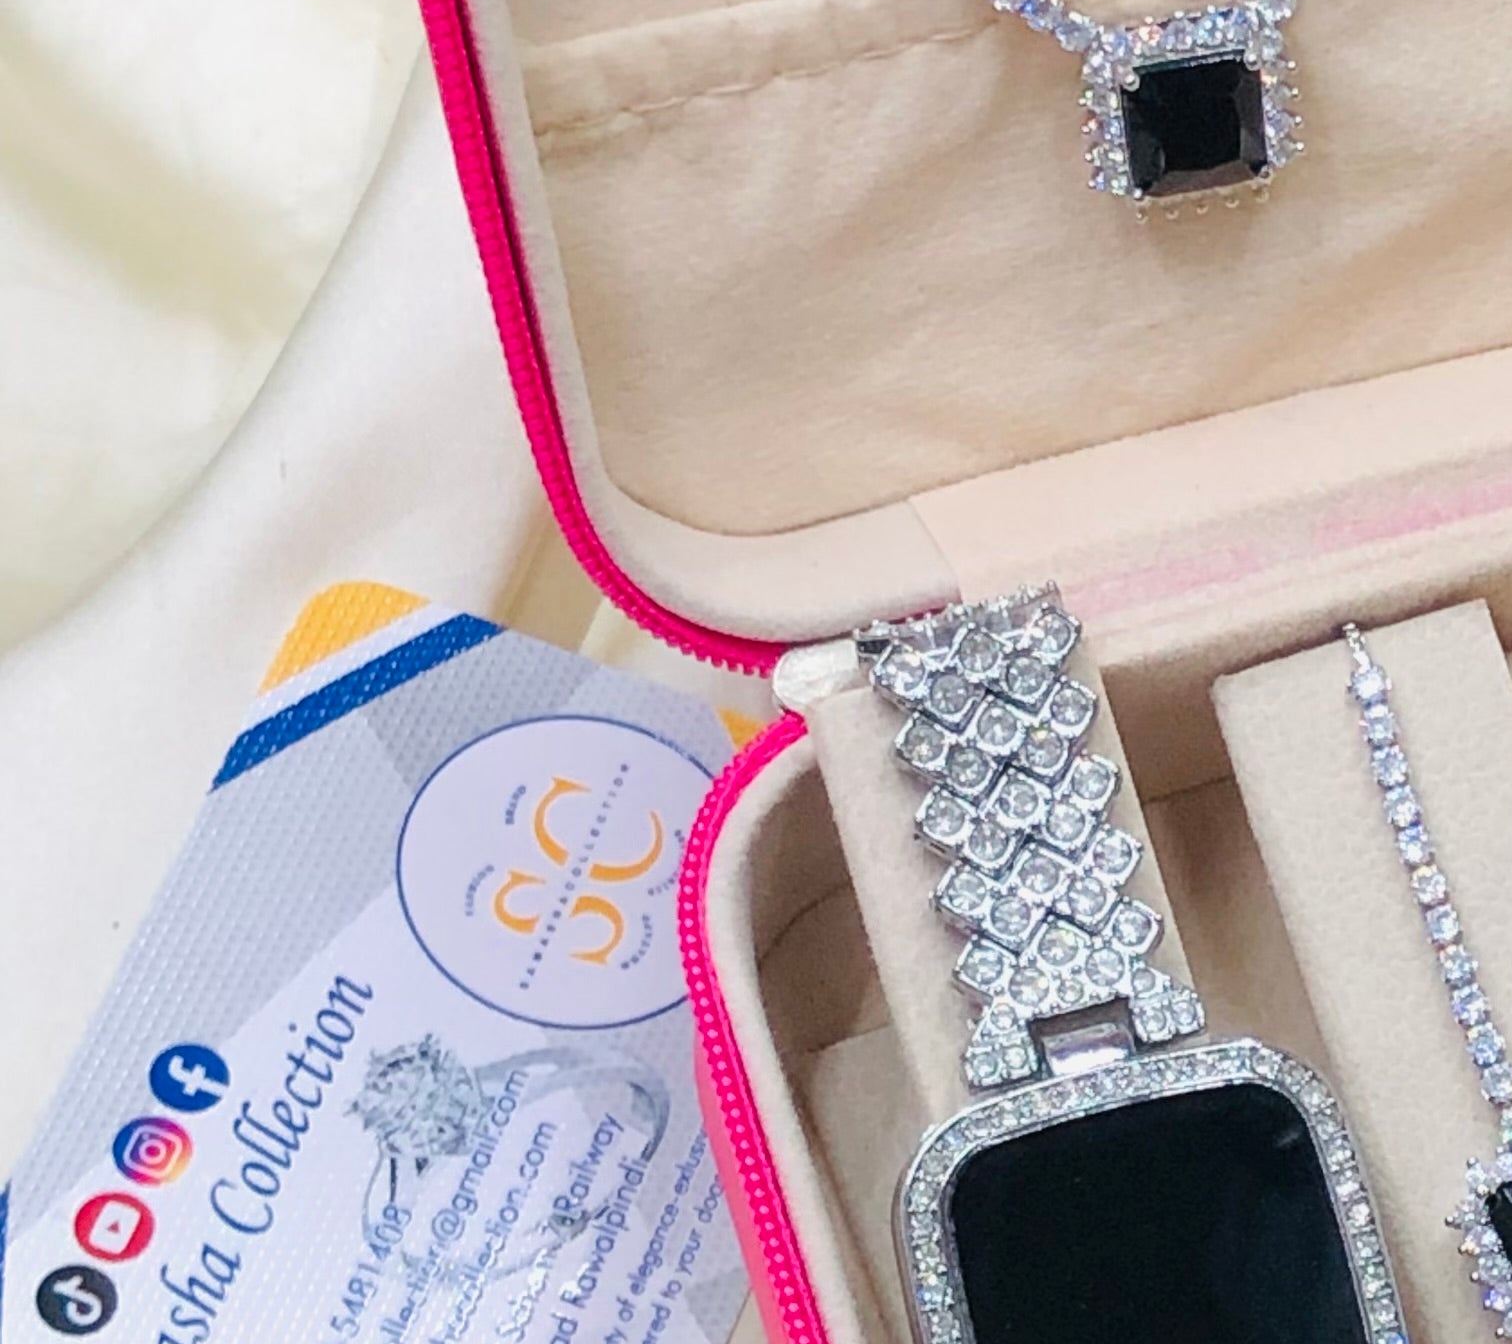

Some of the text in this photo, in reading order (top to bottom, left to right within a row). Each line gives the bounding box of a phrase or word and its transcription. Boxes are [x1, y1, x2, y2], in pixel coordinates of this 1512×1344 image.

[210, 976, 373, 1234] Collection
[557, 1113, 625, 1216] Railway
[560, 1157, 648, 1308] Rawalpindi
[660, 1280, 682, 1299] to
[675, 1227, 704, 1276] your
[616, 1296, 635, 1322] of
